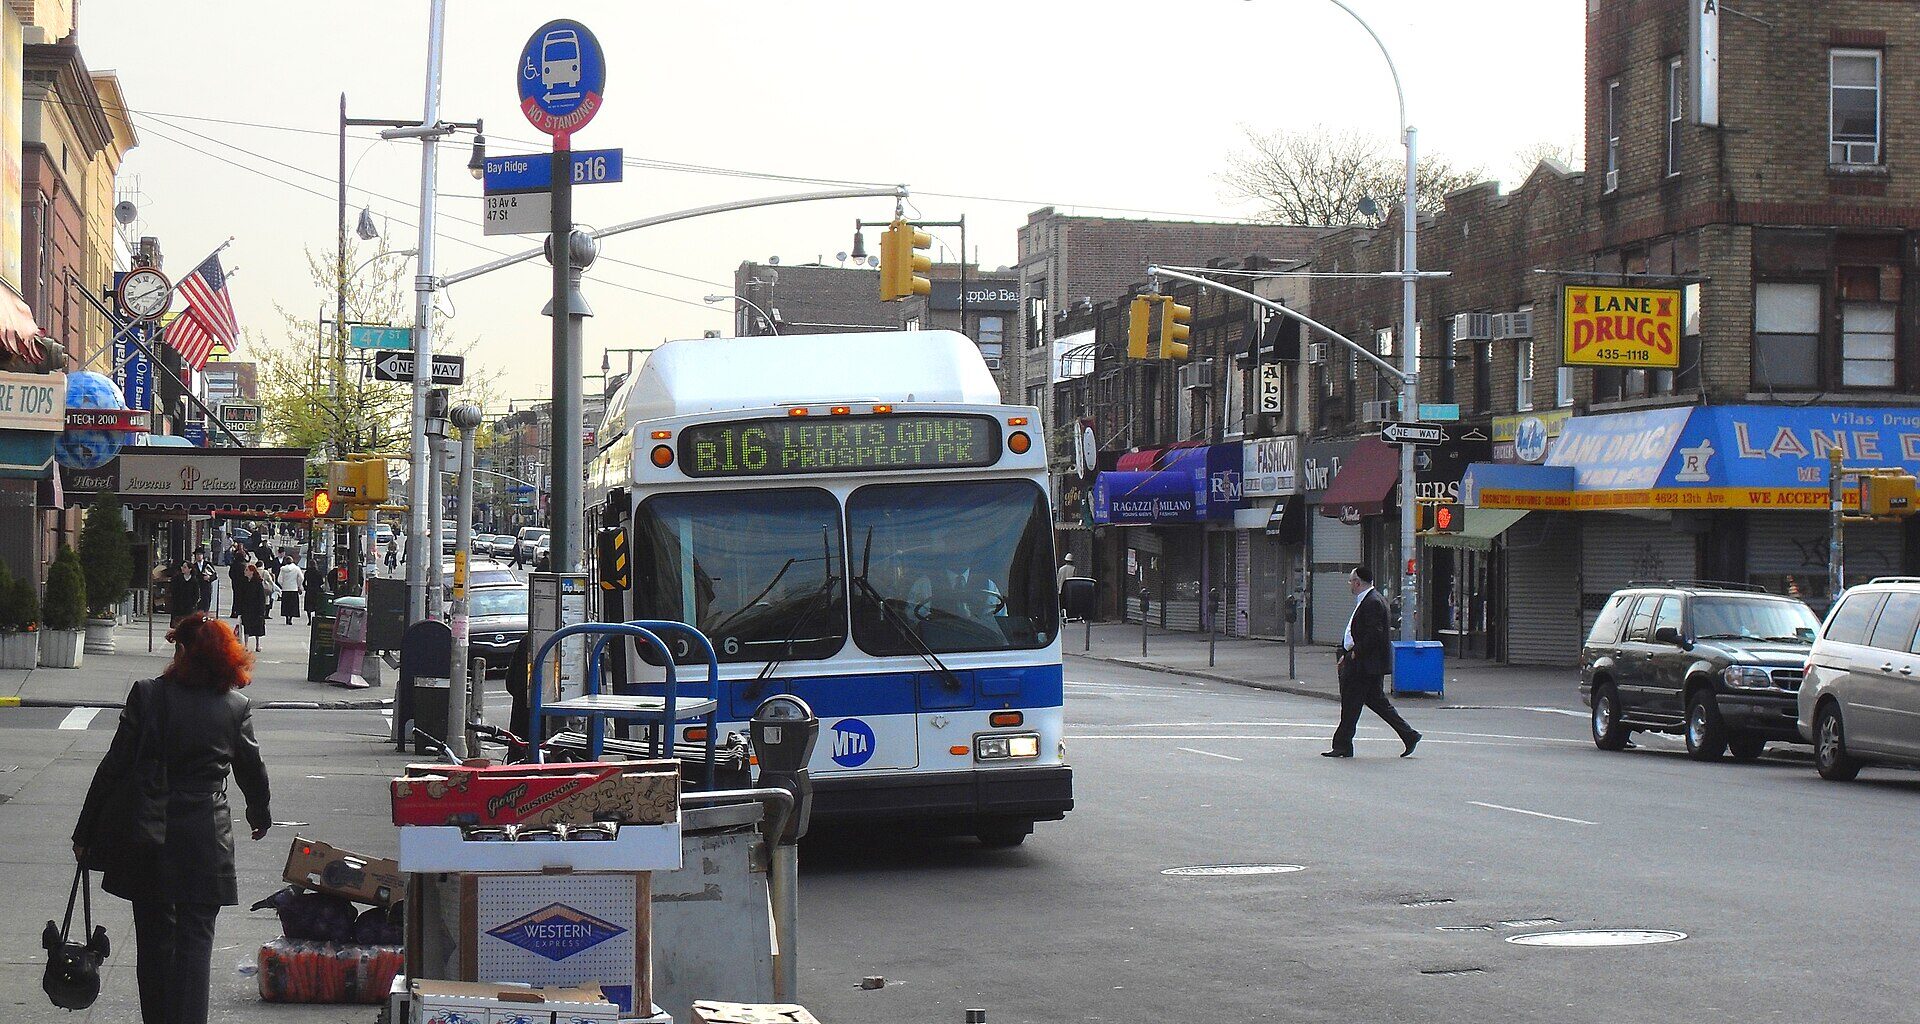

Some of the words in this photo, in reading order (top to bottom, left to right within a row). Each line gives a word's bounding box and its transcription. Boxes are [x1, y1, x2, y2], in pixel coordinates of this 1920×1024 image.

[527, 104, 543, 123] NO
[544, 98, 595, 129] STANDING
[487, 161, 502, 173] Bay
[504, 161, 528, 174] Ridge
[574, 156, 606, 181] B16
[487, 198, 497, 209] 13
[499, 197, 509, 208] Av
[510, 196, 517, 208] &
[487, 210, 497, 221] 47
[499, 209, 508, 220] St
[1594, 296, 1652, 314] LANE
[362, 329, 384, 347] 47
[389, 331, 401, 339] ST
[1573, 315, 1673, 355] DRUGS
[1597, 348, 1649, 361] 435-1118
[389, 361, 414, 373] ONE
[433, 363, 457, 376] WAY
[20, 385, 54, 414] TOPS
[73, 415, 94, 424] TECH
[98, 415, 117, 425] 2000
[1831, 412, 1874, 425] Vilas
[1390, 427, 1409, 437] ONE
[1419, 429, 1438, 438] WAY
[1733, 420, 1883, 460] LANE
[697, 428, 767, 471] B16
[898, 421, 972, 444] GDNS
[782, 445, 926, 468] PROSPECT
[937, 443, 973, 462] PK
[1257, 440, 1295, 473] FASHION
[1305, 458, 1329, 491] Silver
[1797, 466, 1821, 482] WE
[72, 475, 114, 488] Hotel
[125, 478, 172, 490] Avenue
[202, 478, 237, 491] Plaza
[242, 478, 300, 491] Restaurant
[1655, 492, 1678, 503] 4623
[1682, 492, 1702, 503] 13th
[1749, 492, 1771, 504] WE
[1777, 492, 1829, 504] ACCEPT
[1113, 501, 1152, 512] RAGAZZI
[1159, 500, 1191, 511] MILANO
[831, 729, 868, 758] MTA
[485, 782, 529, 819] Giorgio
[517, 779, 580, 815] MUSHROOMS
[524, 924, 592, 939] WESTERN
[535, 940, 581, 948] EXPRESS
